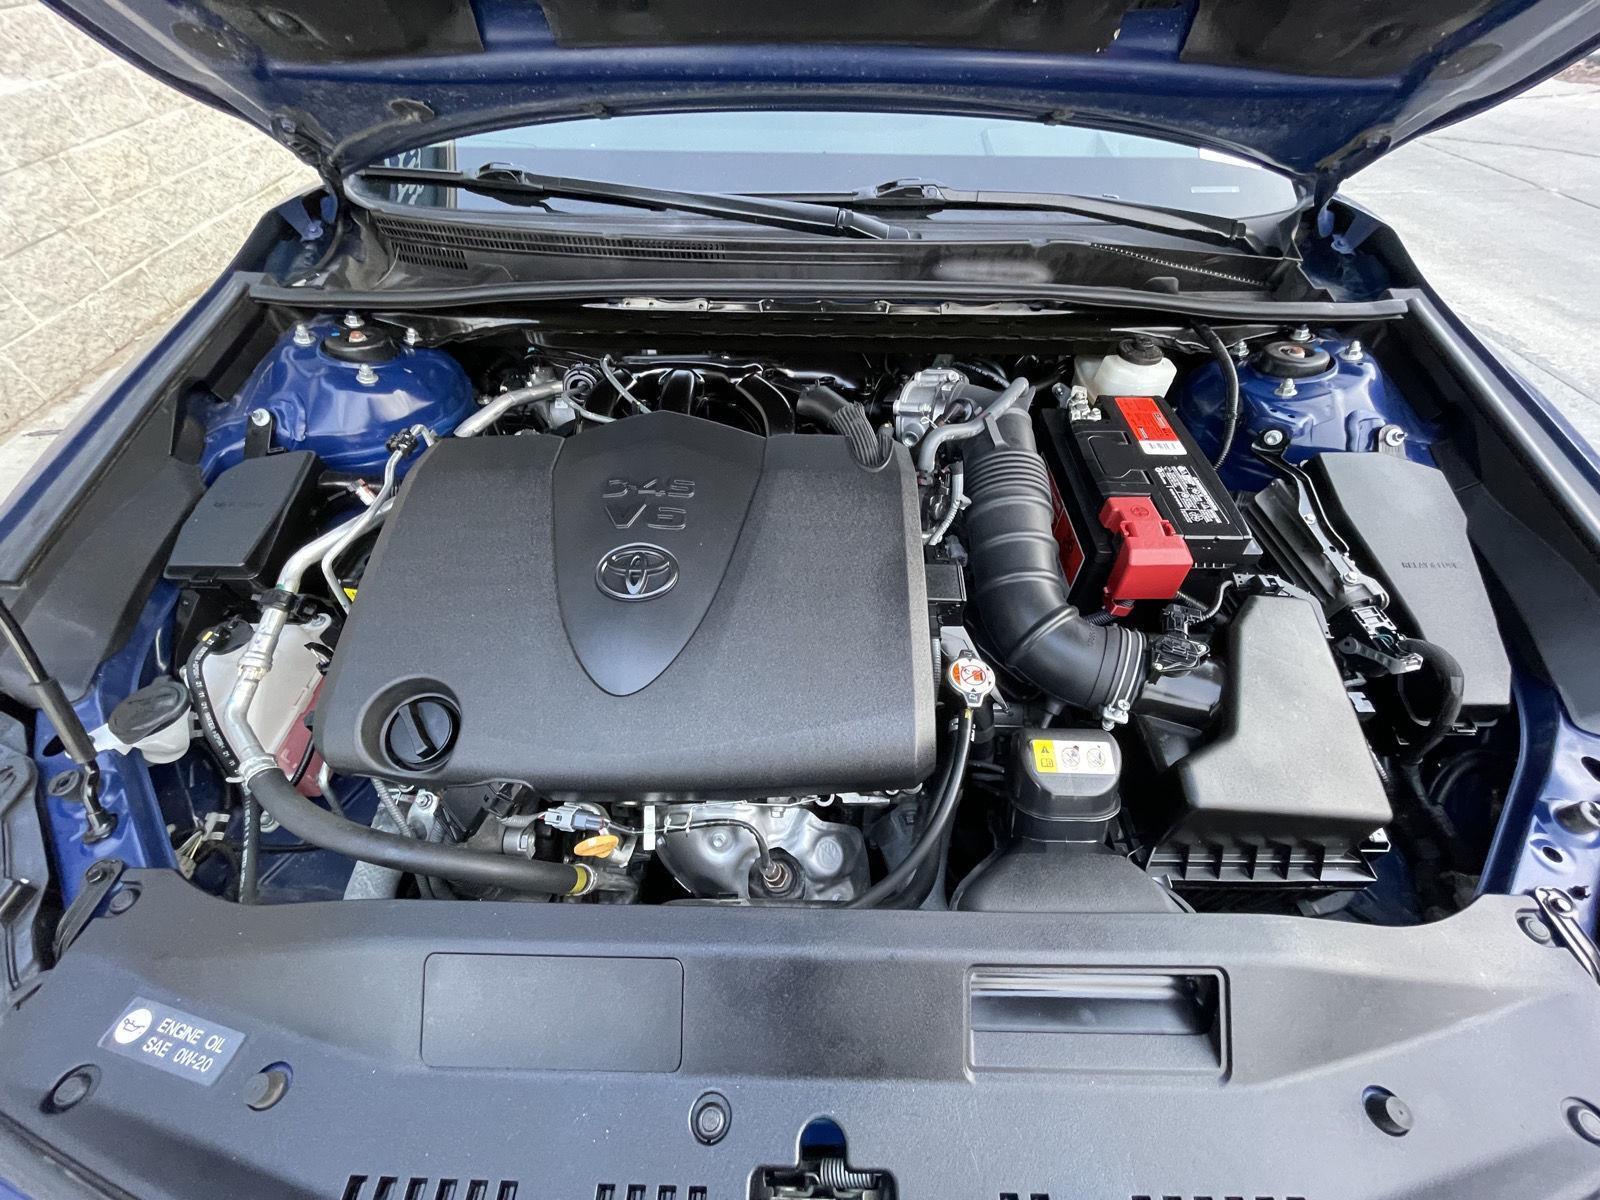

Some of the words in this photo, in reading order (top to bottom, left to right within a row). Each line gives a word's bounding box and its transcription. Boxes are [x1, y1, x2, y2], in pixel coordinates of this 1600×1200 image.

[604, 503, 687, 530] V6
[156, 1017, 205, 1044] ENGINE
[204, 1034, 226, 1054] OIL
[142, 1036, 173, 1058] SAE
[173, 1047, 214, 1072] 0W-20
